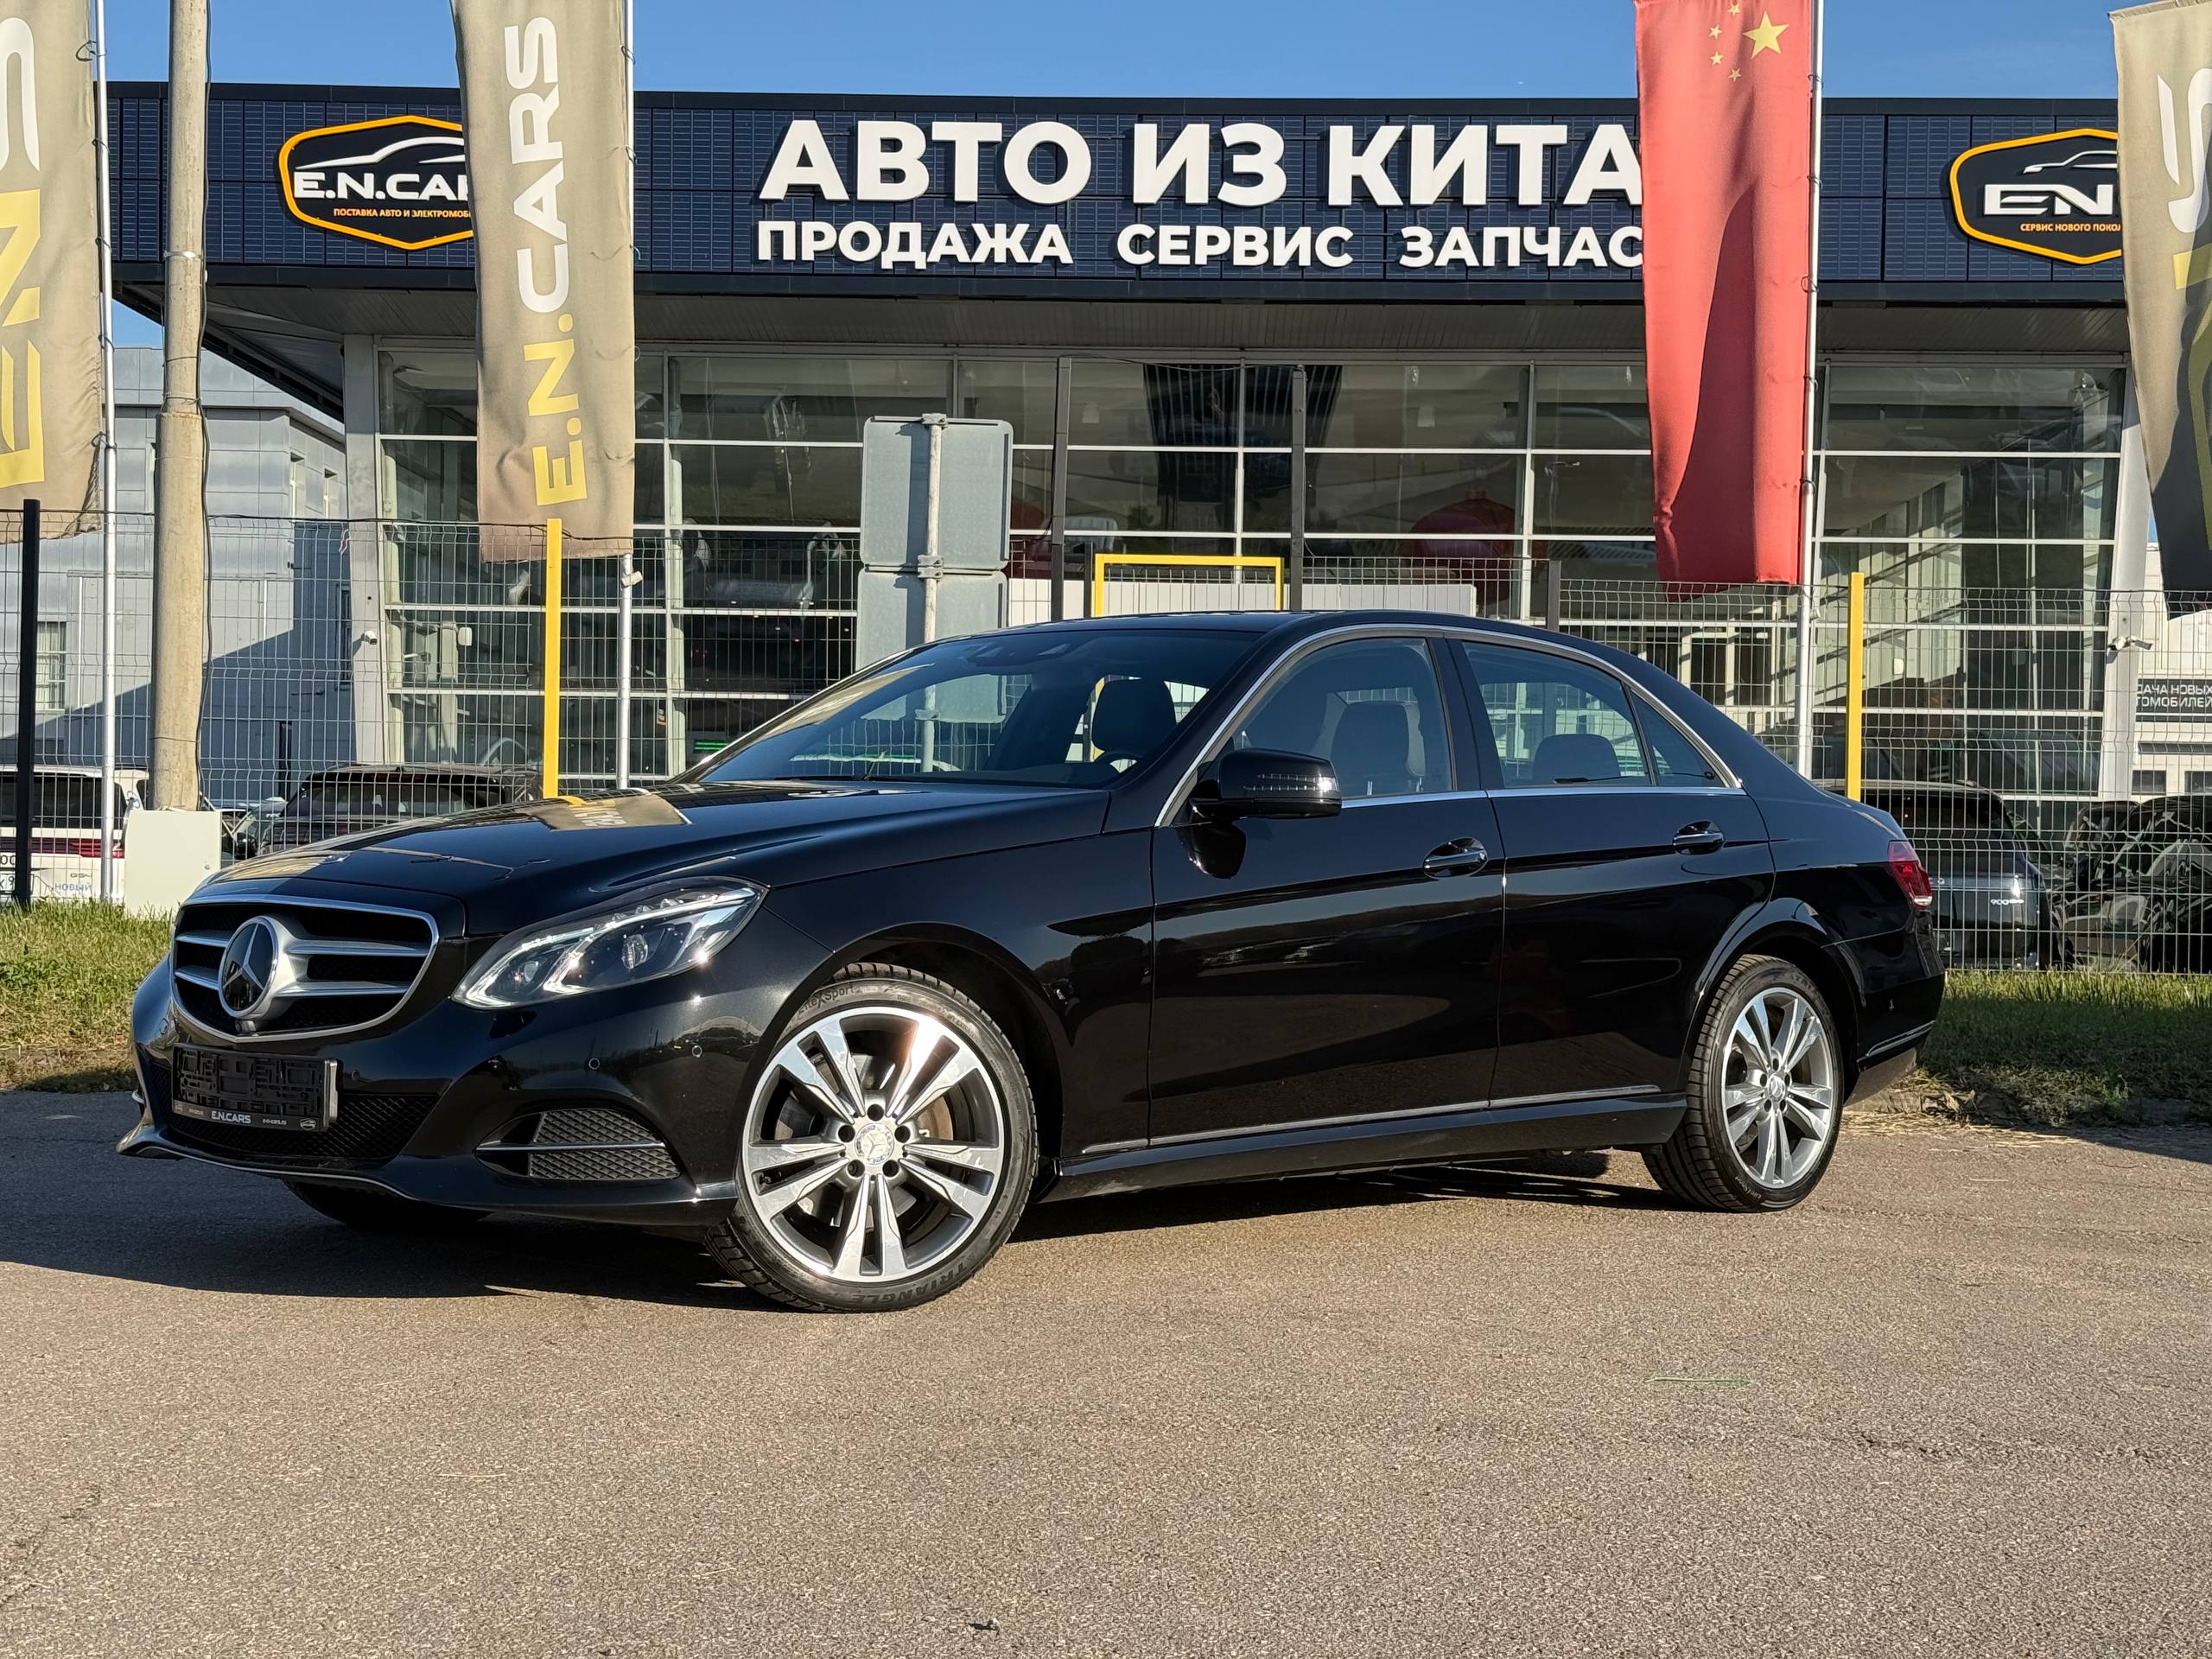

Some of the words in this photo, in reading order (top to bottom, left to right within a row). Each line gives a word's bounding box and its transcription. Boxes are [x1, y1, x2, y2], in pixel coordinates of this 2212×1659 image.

[759, 119, 1092, 206] АВТО
[1132, 122, 1287, 207] ИЗ
[1328, 124, 1643, 207] КИТА
[334, 208, 378, 217] ПОСТАВКА
[411, 209, 472, 218] ЭЛЕКТРОМОБ
[1984, 184, 2113, 215] EN
[2020, 223, 2053, 232] СЕРВИС
[2055, 223, 2091, 232] НОВОГО
[758, 220, 1073, 270] ПРОДАЖА
[1117, 223, 1354, 269] СЕРВИС
[1400, 226, 1643, 269] ЗАПЧАС
[505, 16, 588, 506] E.N.CARS
[211, 1110, 251, 1124] E.N.CARS
